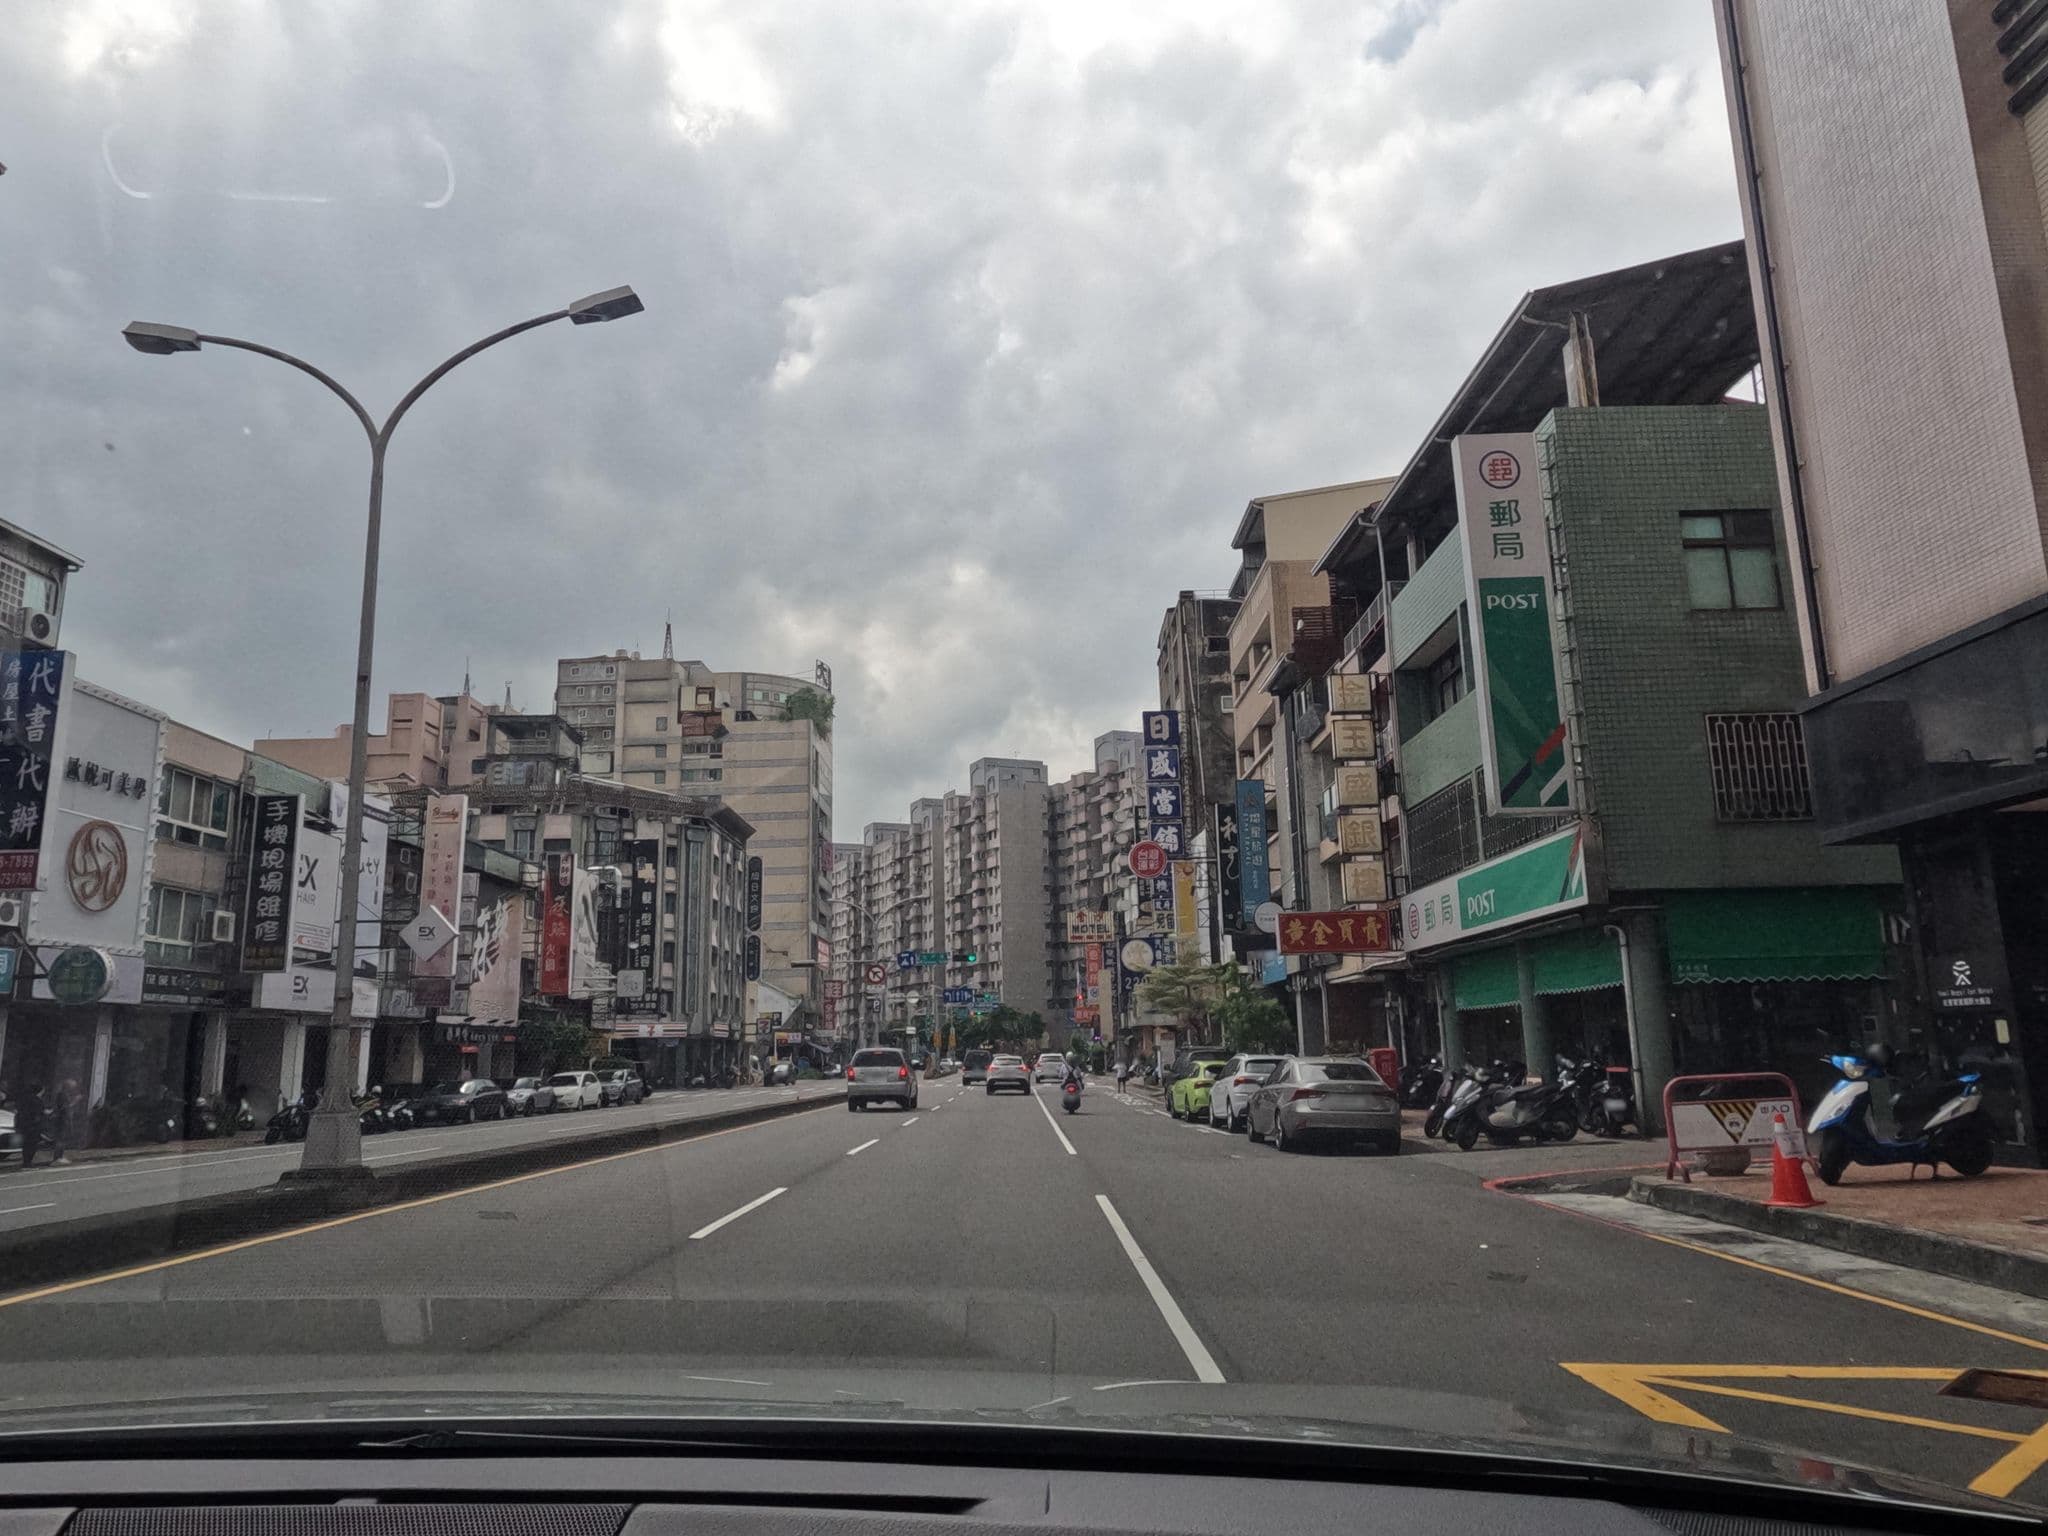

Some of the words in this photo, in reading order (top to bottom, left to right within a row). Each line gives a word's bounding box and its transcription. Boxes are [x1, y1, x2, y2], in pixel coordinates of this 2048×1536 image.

[1489, 500, 1524, 560] 郵局
[1486, 593, 1541, 611] POST
[8, 656, 56, 843] 代書代辦
[254, 800, 290, 942] 手機現場維修
[1467, 889, 1495, 920] POST
[1072, 924, 1109, 934] MOTEL
[1285, 915, 1381, 946] 黃金買賣
[1760, 1104, 1790, 1113] 出入口
